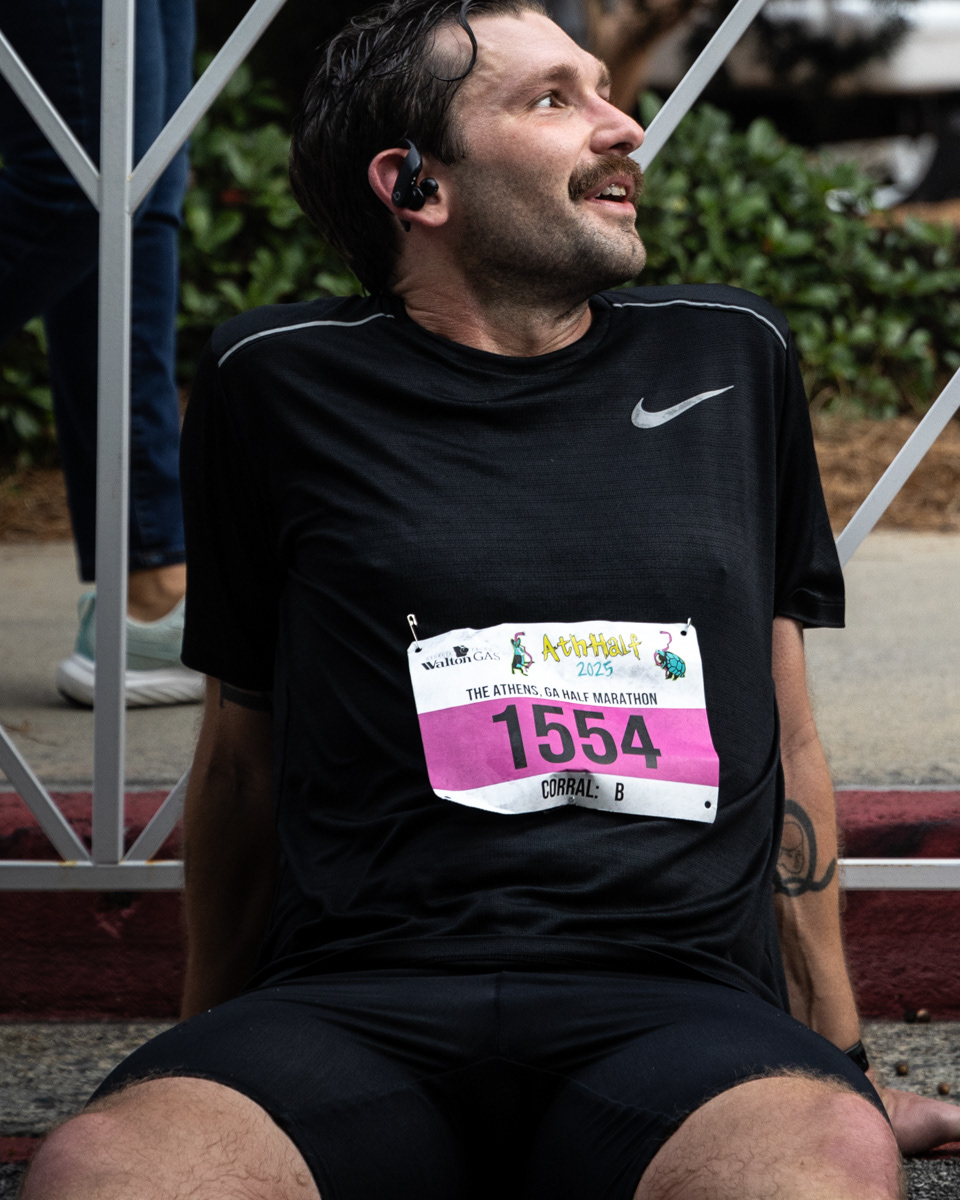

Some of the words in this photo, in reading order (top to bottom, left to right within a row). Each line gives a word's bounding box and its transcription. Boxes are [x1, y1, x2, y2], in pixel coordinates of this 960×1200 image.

[421, 656, 472, 671] Walton
[473, 651, 501, 662] GAS
[576, 660, 614, 677] 2025
[466, 685, 490, 701] THE
[493, 683, 543, 697] ATHENS,
[544, 686, 560, 698] GA
[562, 689, 589, 703] HALF
[592, 692, 658, 705] MARATHON
[492, 704, 662, 770] 1554
[541, 777, 600, 800] CORRAL:
[614, 782, 625, 801] B
